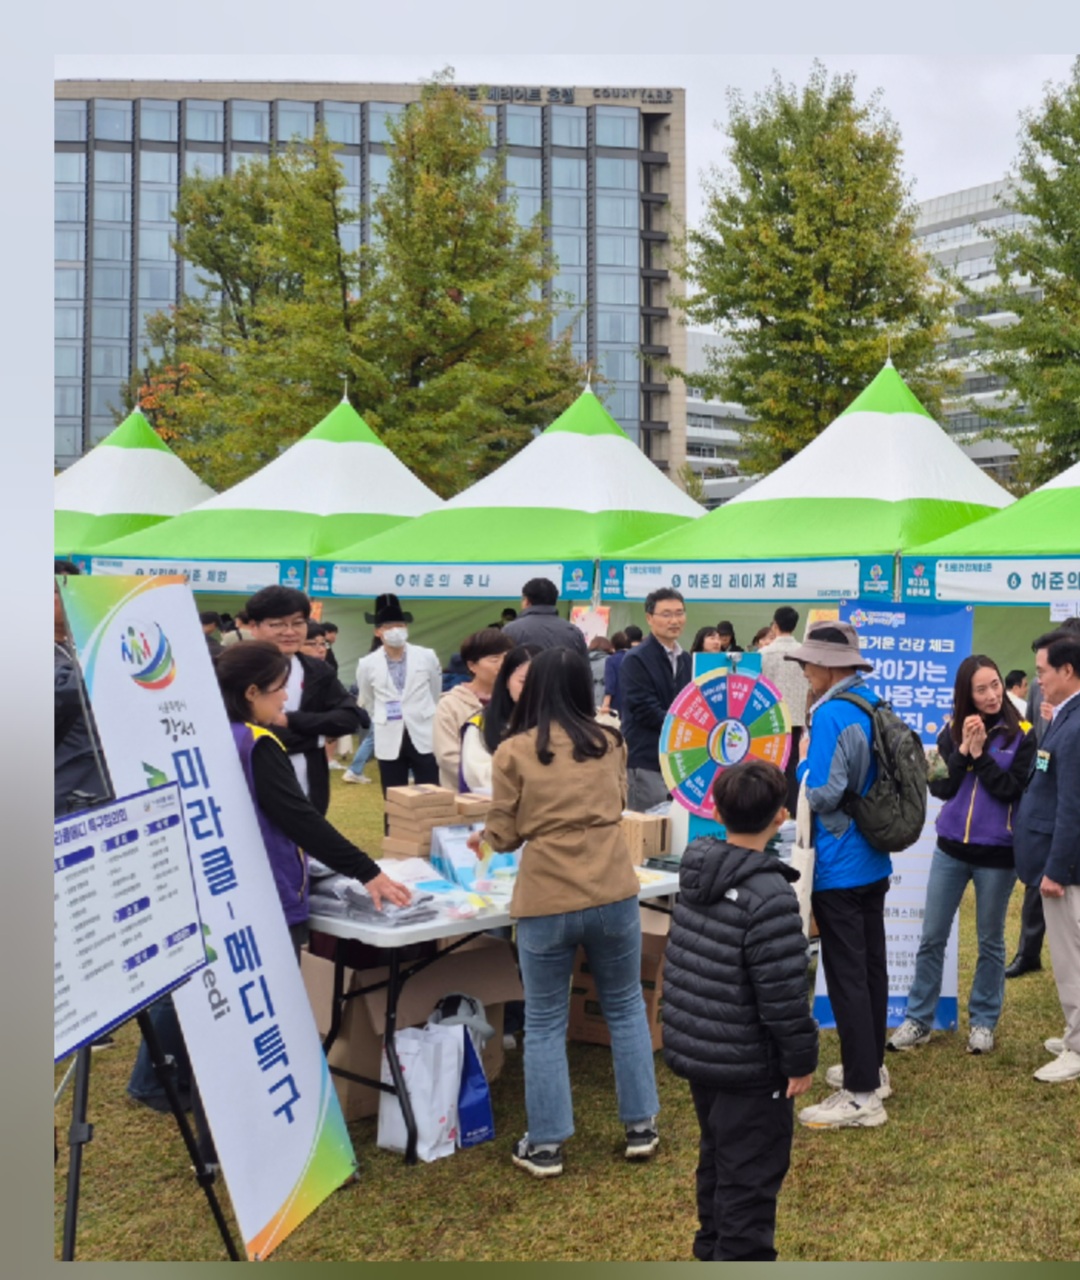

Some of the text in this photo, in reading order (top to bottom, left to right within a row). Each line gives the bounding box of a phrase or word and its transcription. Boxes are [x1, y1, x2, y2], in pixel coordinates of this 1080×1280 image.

[593, 88, 674, 100] COURTYARD
[408, 573, 490, 588] 허준의 추나
[688, 572, 799, 589] 허준의 레이저 치료
[898, 637, 925, 652] 건강
[928, 639, 956, 653] 체크
[160, 718, 197, 743] 강서
